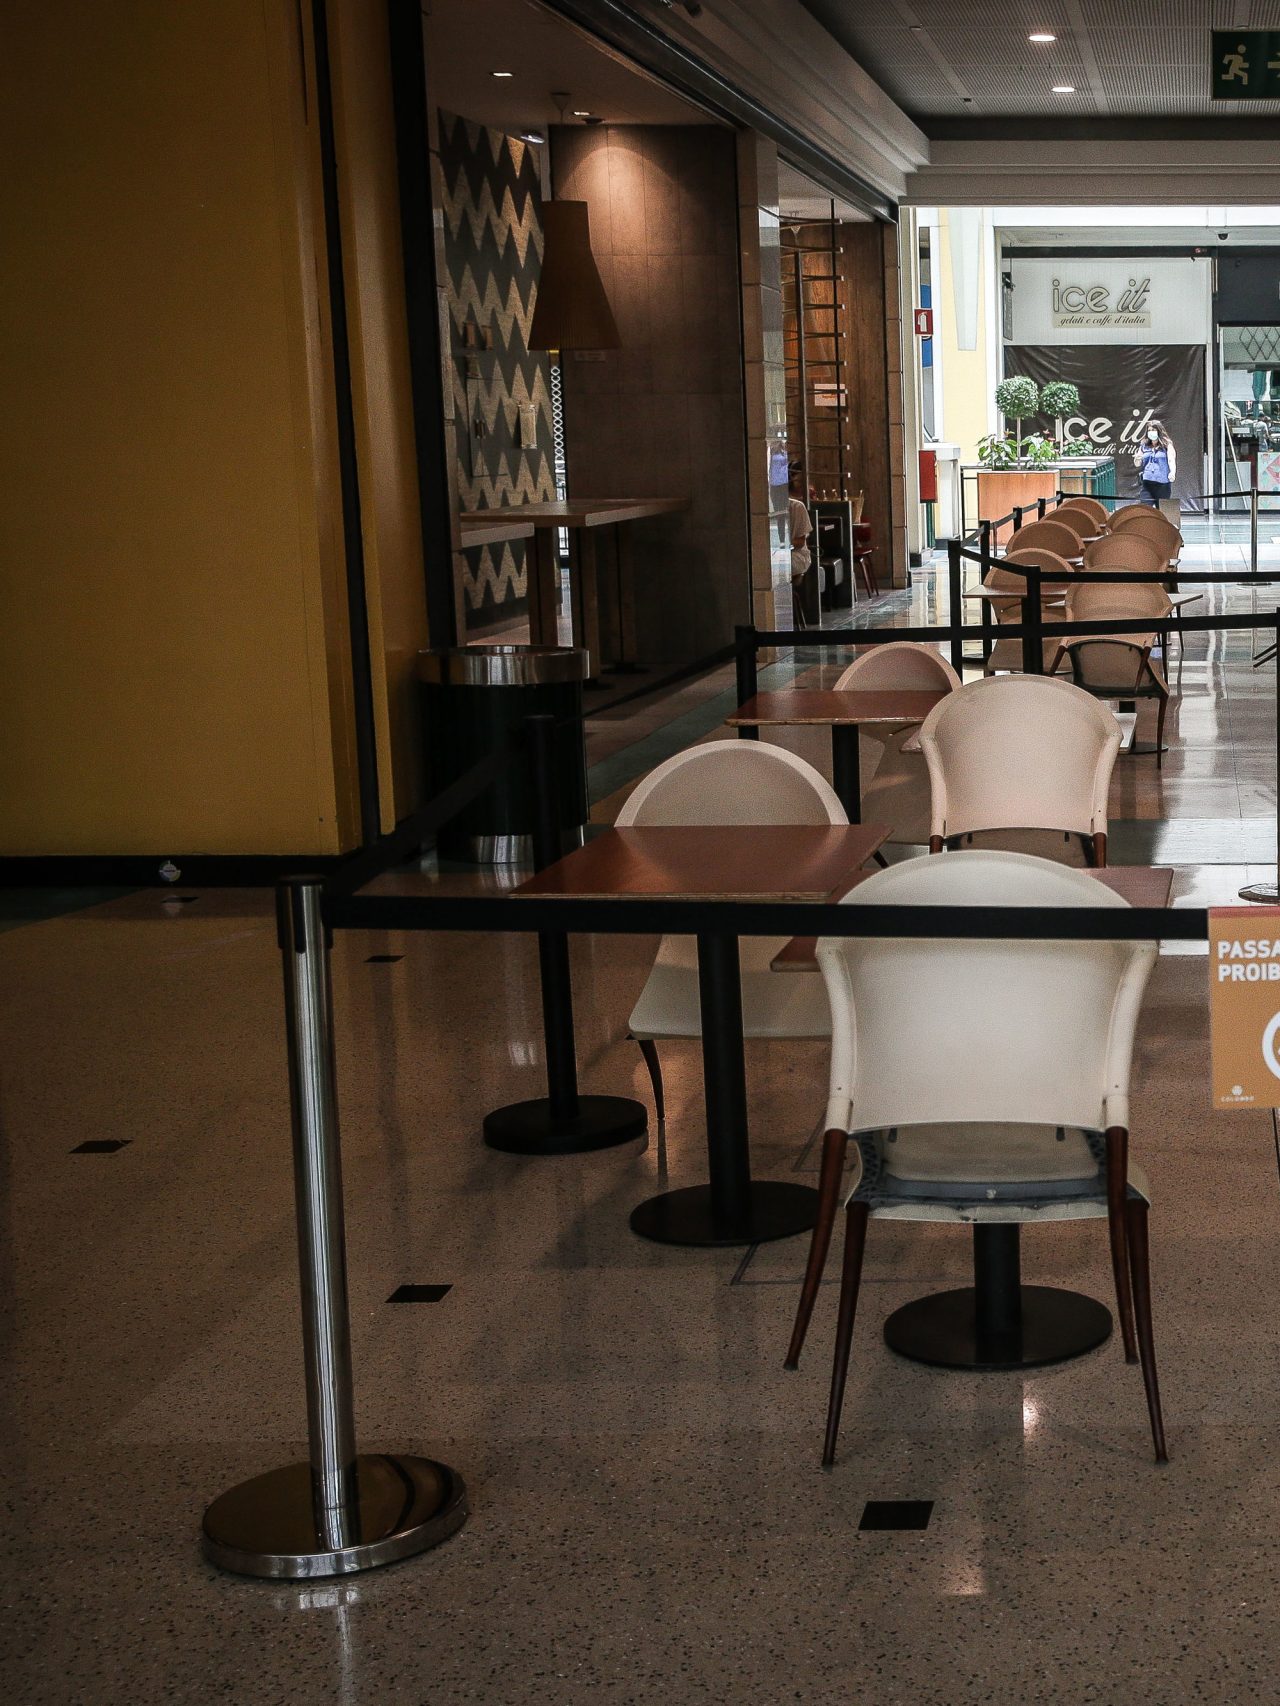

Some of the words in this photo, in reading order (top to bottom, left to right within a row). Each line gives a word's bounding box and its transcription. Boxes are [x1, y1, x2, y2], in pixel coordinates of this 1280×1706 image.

[1052, 279, 1110, 313] ice
[1117, 278, 1151, 313] it
[1058, 315, 1085, 327] gelati
[1120, 408, 1155, 443] it
